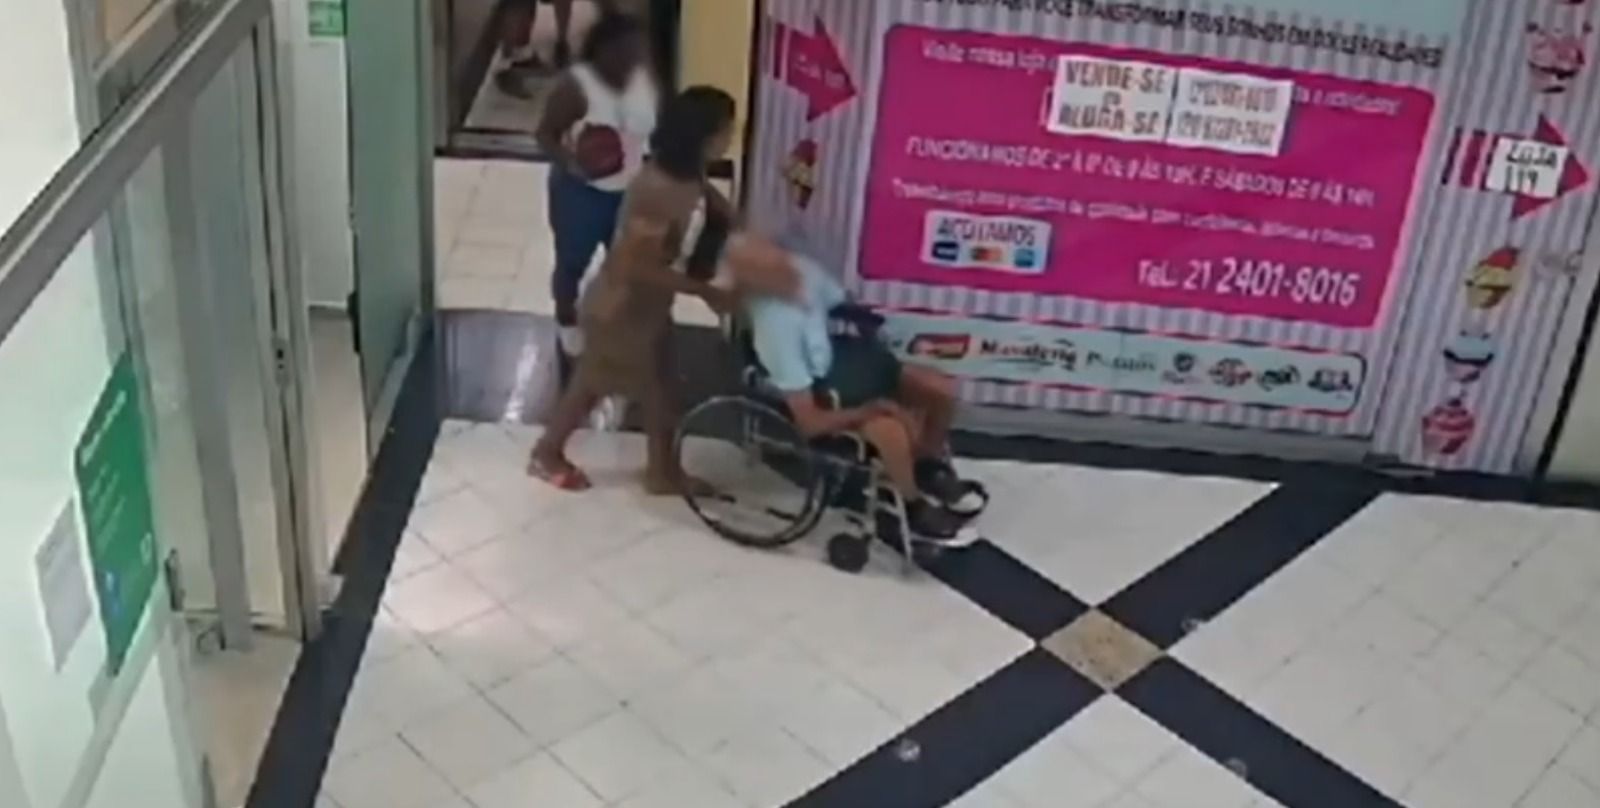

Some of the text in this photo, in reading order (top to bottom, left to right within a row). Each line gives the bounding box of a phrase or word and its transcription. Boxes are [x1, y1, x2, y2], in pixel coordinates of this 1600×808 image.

[1065, 60, 1166, 94] VENDE-SE
[1057, 103, 1160, 135] ALUGA-SE
[906, 135, 1026, 167] FUNCIONAMOS
[1183, 260, 1212, 290] 21
[1215, 257, 1361, 307] 2401-8016
